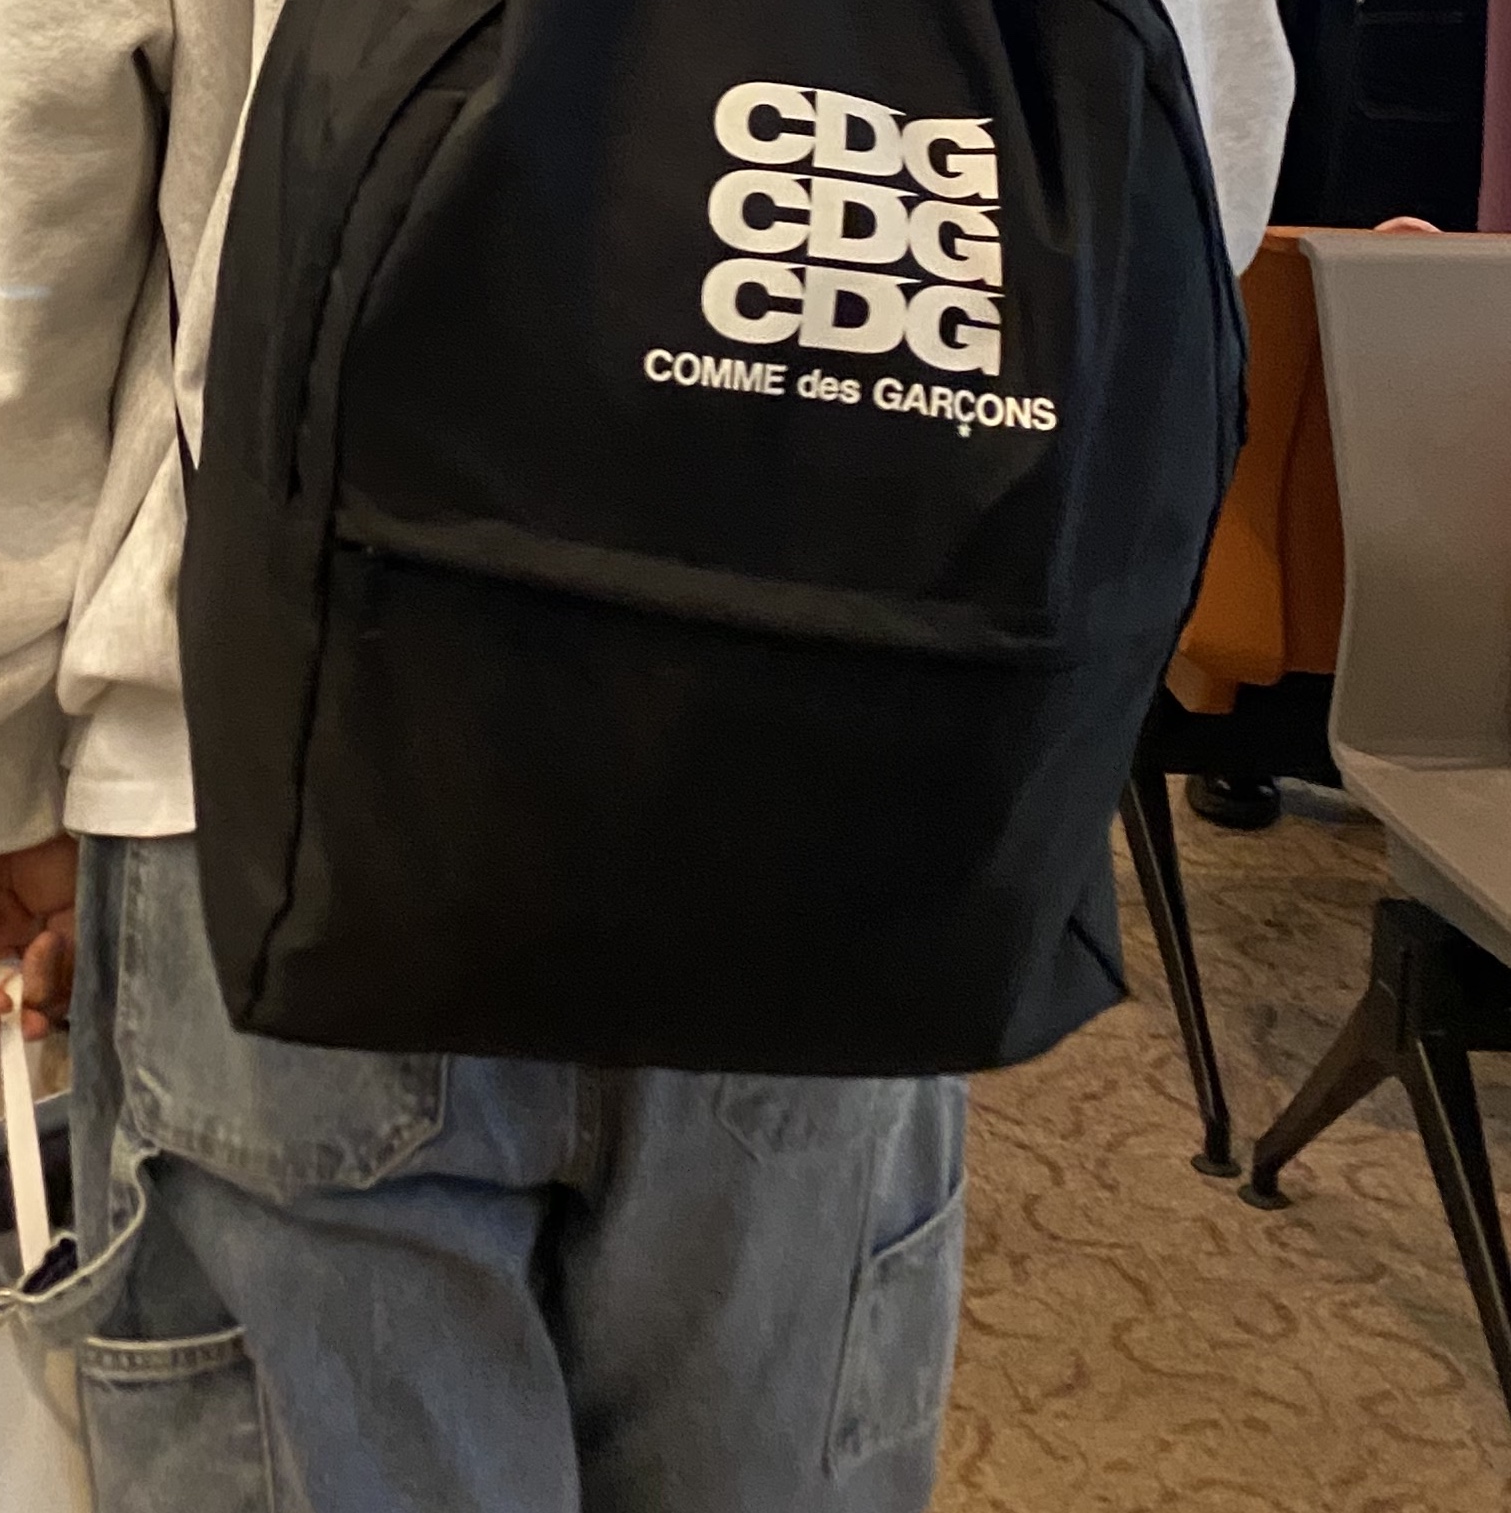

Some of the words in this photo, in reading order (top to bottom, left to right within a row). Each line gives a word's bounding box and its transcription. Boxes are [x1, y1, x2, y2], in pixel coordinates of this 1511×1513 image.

[714, 82, 999, 199] CDG
[708, 169, 1003, 286] CDG
[701, 258, 1006, 376] CDG
[643, 348, 788, 396] COMME
[797, 368, 861, 404] des
[873, 377, 1057, 435] GARÇONS
